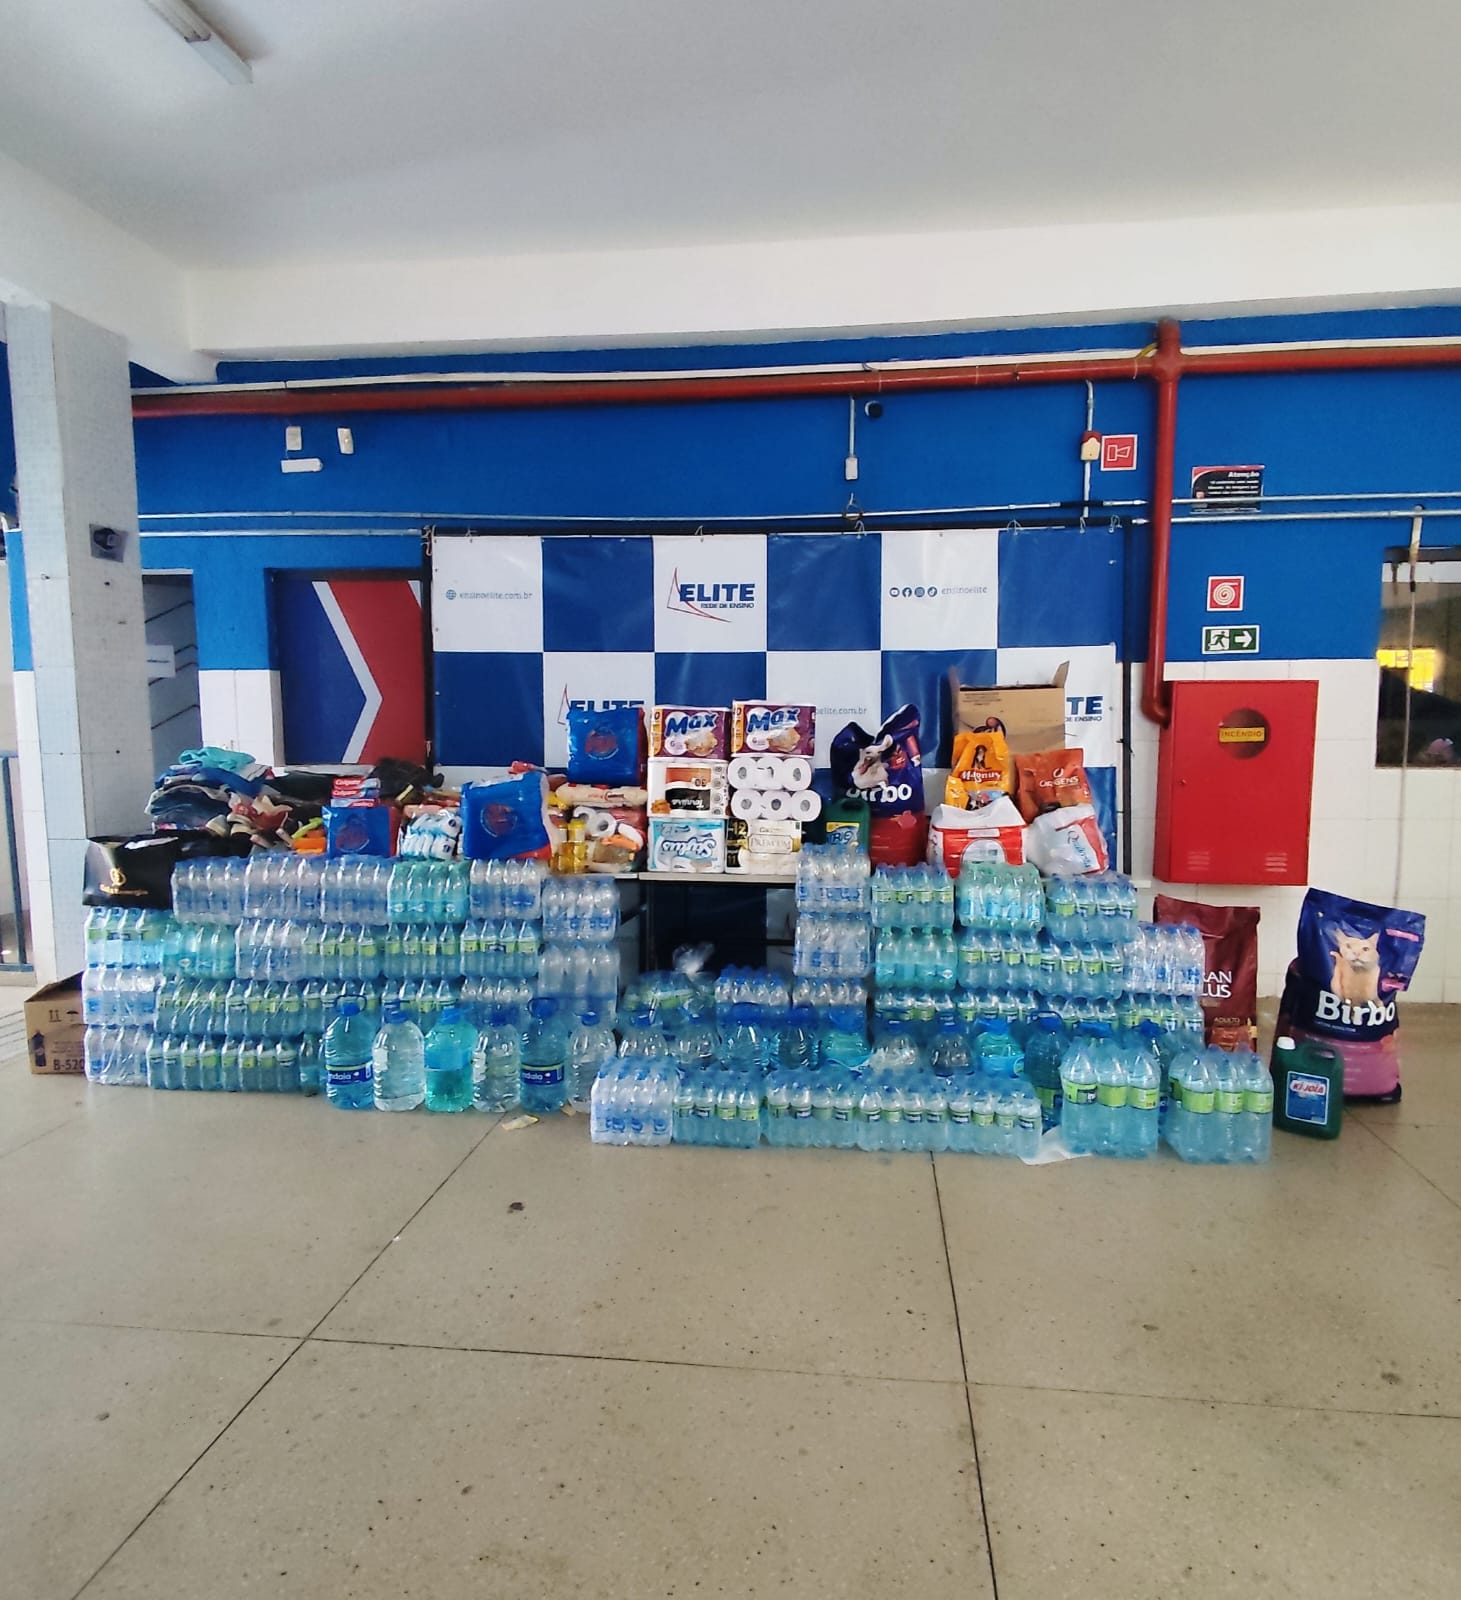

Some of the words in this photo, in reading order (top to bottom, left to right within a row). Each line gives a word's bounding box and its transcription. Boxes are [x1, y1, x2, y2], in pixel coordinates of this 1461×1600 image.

[459, 591, 533, 600] ensinoelite.com.br
[680, 583, 755, 602] ELITE
[941, 586, 988, 595] ensinoelite
[665, 714, 717, 737] Max
[747, 710, 799, 733] Max
[1315, 990, 1396, 1026] Birbo
